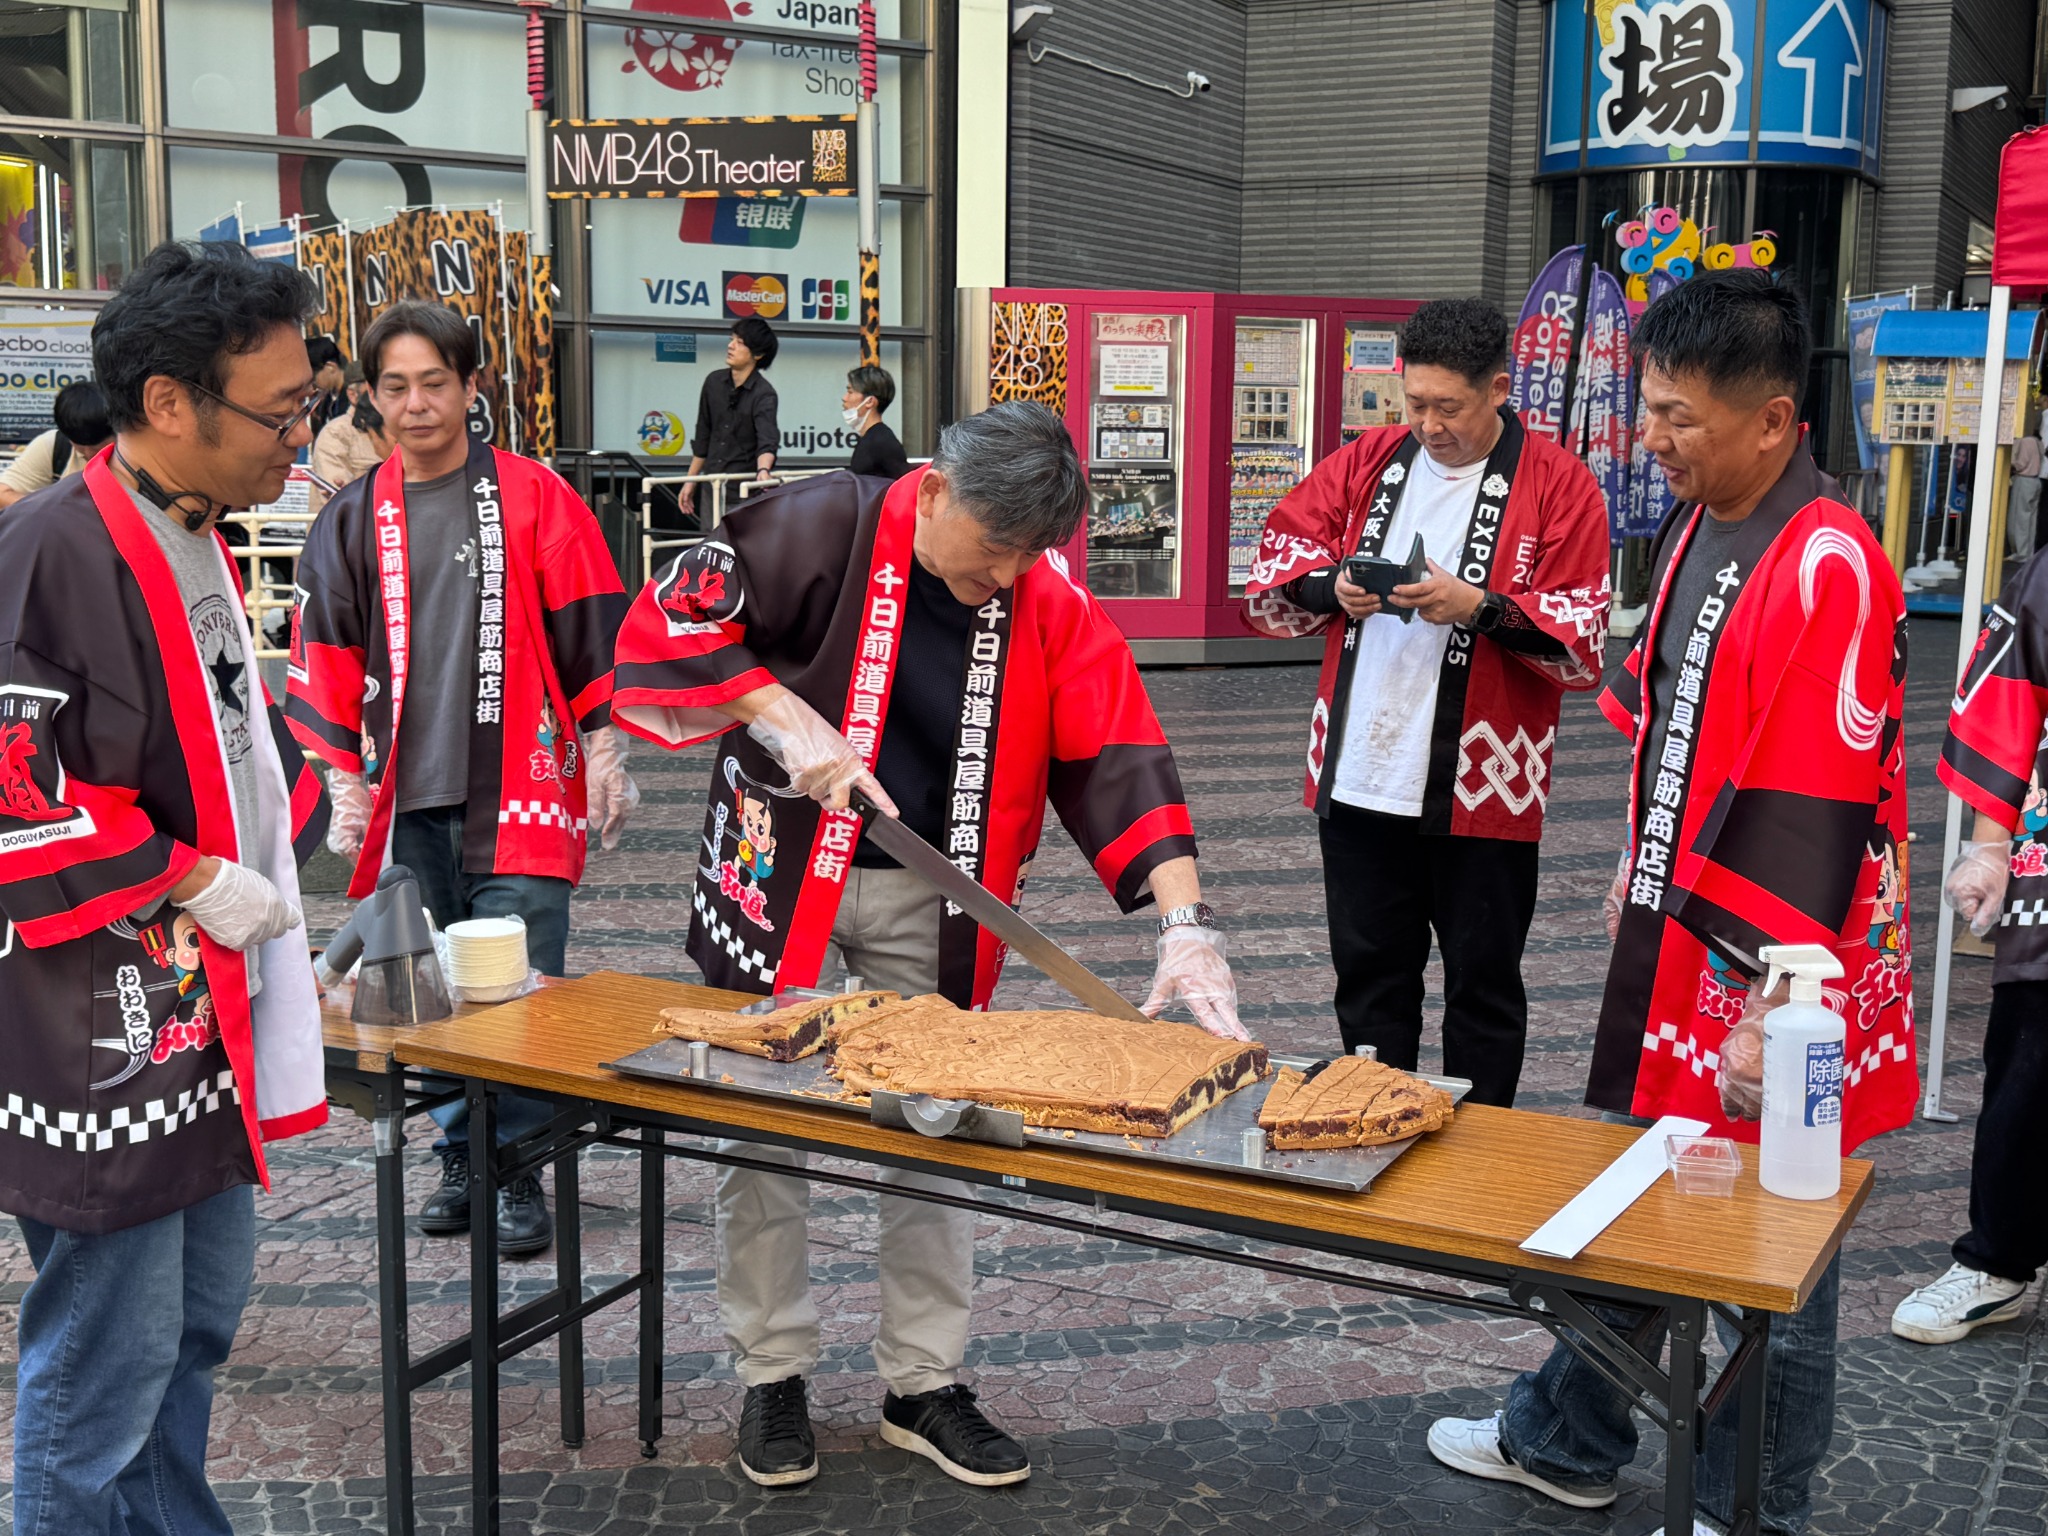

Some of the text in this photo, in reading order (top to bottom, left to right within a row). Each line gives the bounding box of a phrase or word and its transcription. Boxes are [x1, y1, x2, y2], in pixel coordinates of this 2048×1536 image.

[1607, 4, 1731, 136] 場
[553, 131, 805, 185] NMB48 Theater
[735, 203, 793, 230] 银联
[641, 277, 711, 306] VISA
[726, 289, 785, 305] MasterCard
[991, 302, 1069, 346] NMB
[990, 345, 1044, 389] 48
[1527, 290, 1561, 432] Comed
[778, 426, 860, 454] uijote
[1463, 502, 1501, 585] EXPO
[473, 478, 505, 724] 千日前道具屋筋商店街
[813, 562, 904, 884] 千日前道具屋店街
[1630, 560, 1741, 912] 千日前道具屋筋商店街
[1, 825, 72, 848] DOGUYASUJI
[117, 966, 152, 1053] おおきに
[1809, 1056, 1844, 1083] 除菌
